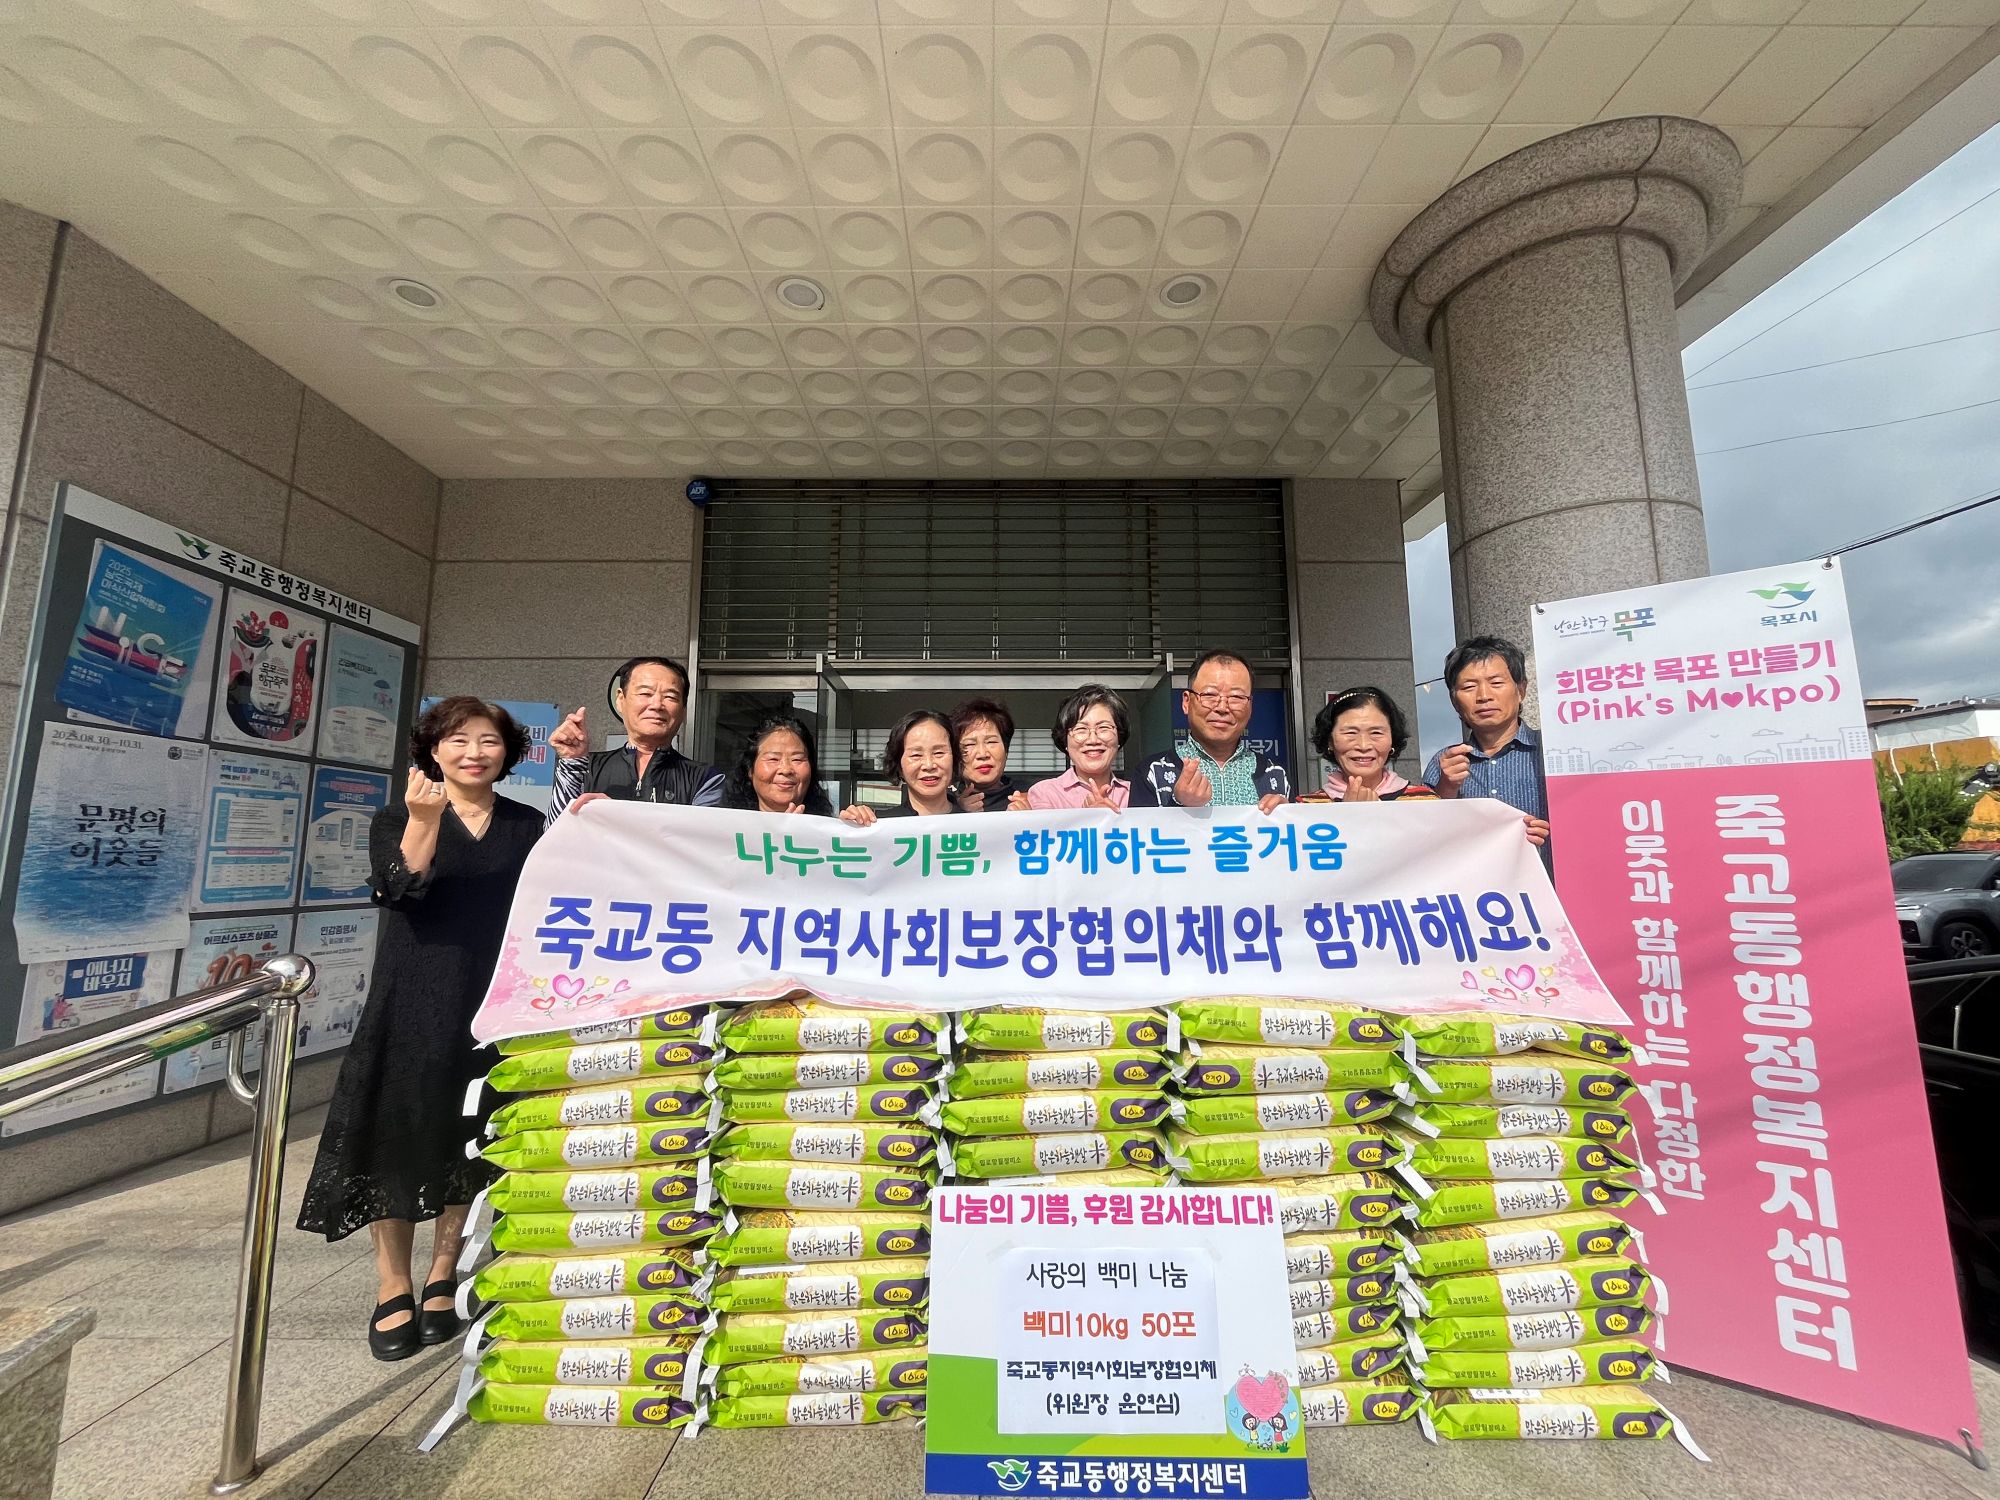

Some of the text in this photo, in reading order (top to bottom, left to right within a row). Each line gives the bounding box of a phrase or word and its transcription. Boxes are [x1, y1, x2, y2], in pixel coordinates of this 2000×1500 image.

[690, 486, 706, 496] ADT
[108, 560, 132, 576] 2025
[218, 550, 371, 624] 죽교동행정복지센터
[1613, 606, 1656, 642] 목포
[1760, 609, 1818, 627] 목포시
[1556, 639, 1836, 695] 희망찬 목포 만들기
[1557, 686, 1675, 725] (Pink's
[75, 804, 167, 835] 문명의
[70, 837, 164, 866] 이웃들
[735, 822, 1347, 880] 나누는 기쁨, 함께하는 즐거움
[320, 924, 358, 936] 인감증명서
[535, 891, 1551, 979] 죽교동 지역사회보장협의체와 함께해요!
[83, 972, 131, 992] 바우처
[86, 958, 133, 976] 에너지
[1622, 800, 1705, 1201] 이웃과 함께하는 다정한
[1715, 794, 1859, 1371] 죽교동행정복지센터
[939, 1194, 1274, 1228] 나눔의 기쁨, 후원 감사합니다!
[1026, 1261, 1188, 1290] 사랑의 백미 나눔
[1023, 1310, 1197, 1340] 백미10kg 50포
[1006, 1359, 1217, 1380] 죽교동지역사회보장협의체
[1046, 1391, 1180, 1416] (위원장 윤연심)
[1036, 1460, 1247, 1495] 죽교동행정복지센터
